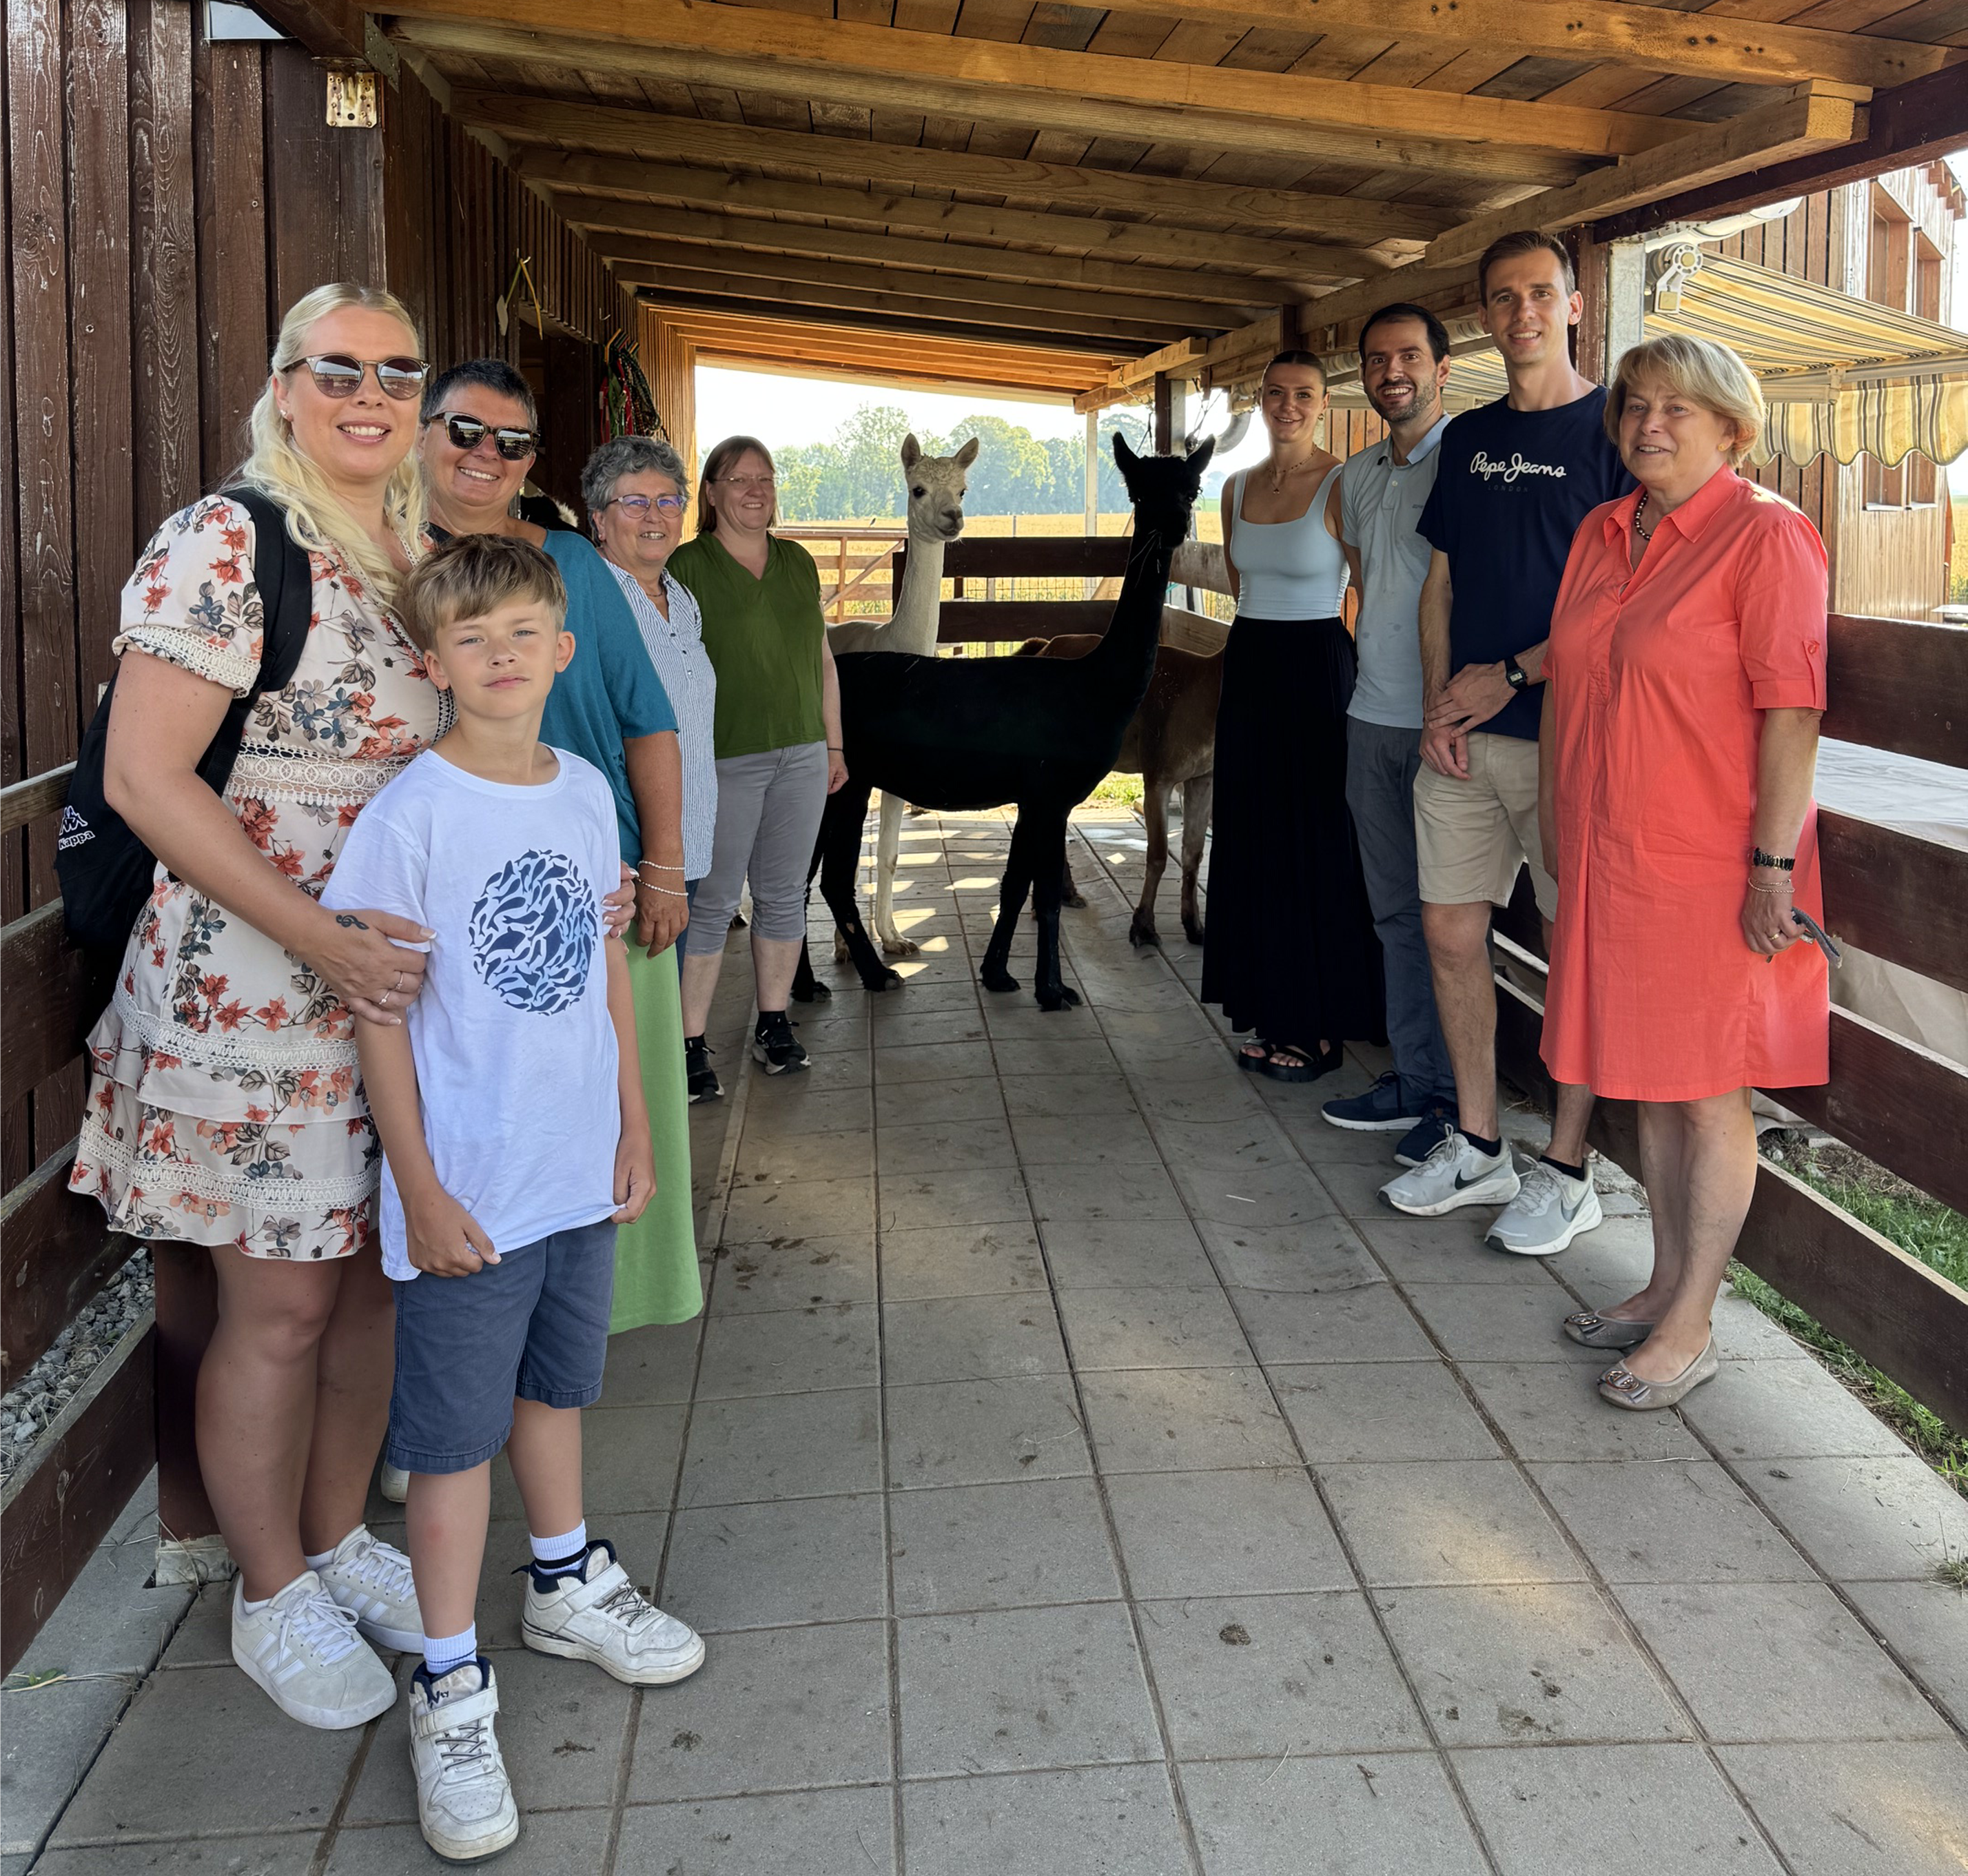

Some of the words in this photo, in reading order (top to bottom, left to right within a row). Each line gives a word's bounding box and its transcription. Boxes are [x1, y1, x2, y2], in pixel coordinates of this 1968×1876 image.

[1470, 451, 1507, 481] Pepe
[1504, 453, 1567, 482] Jeans
[59, 830, 96, 850] Kappa
